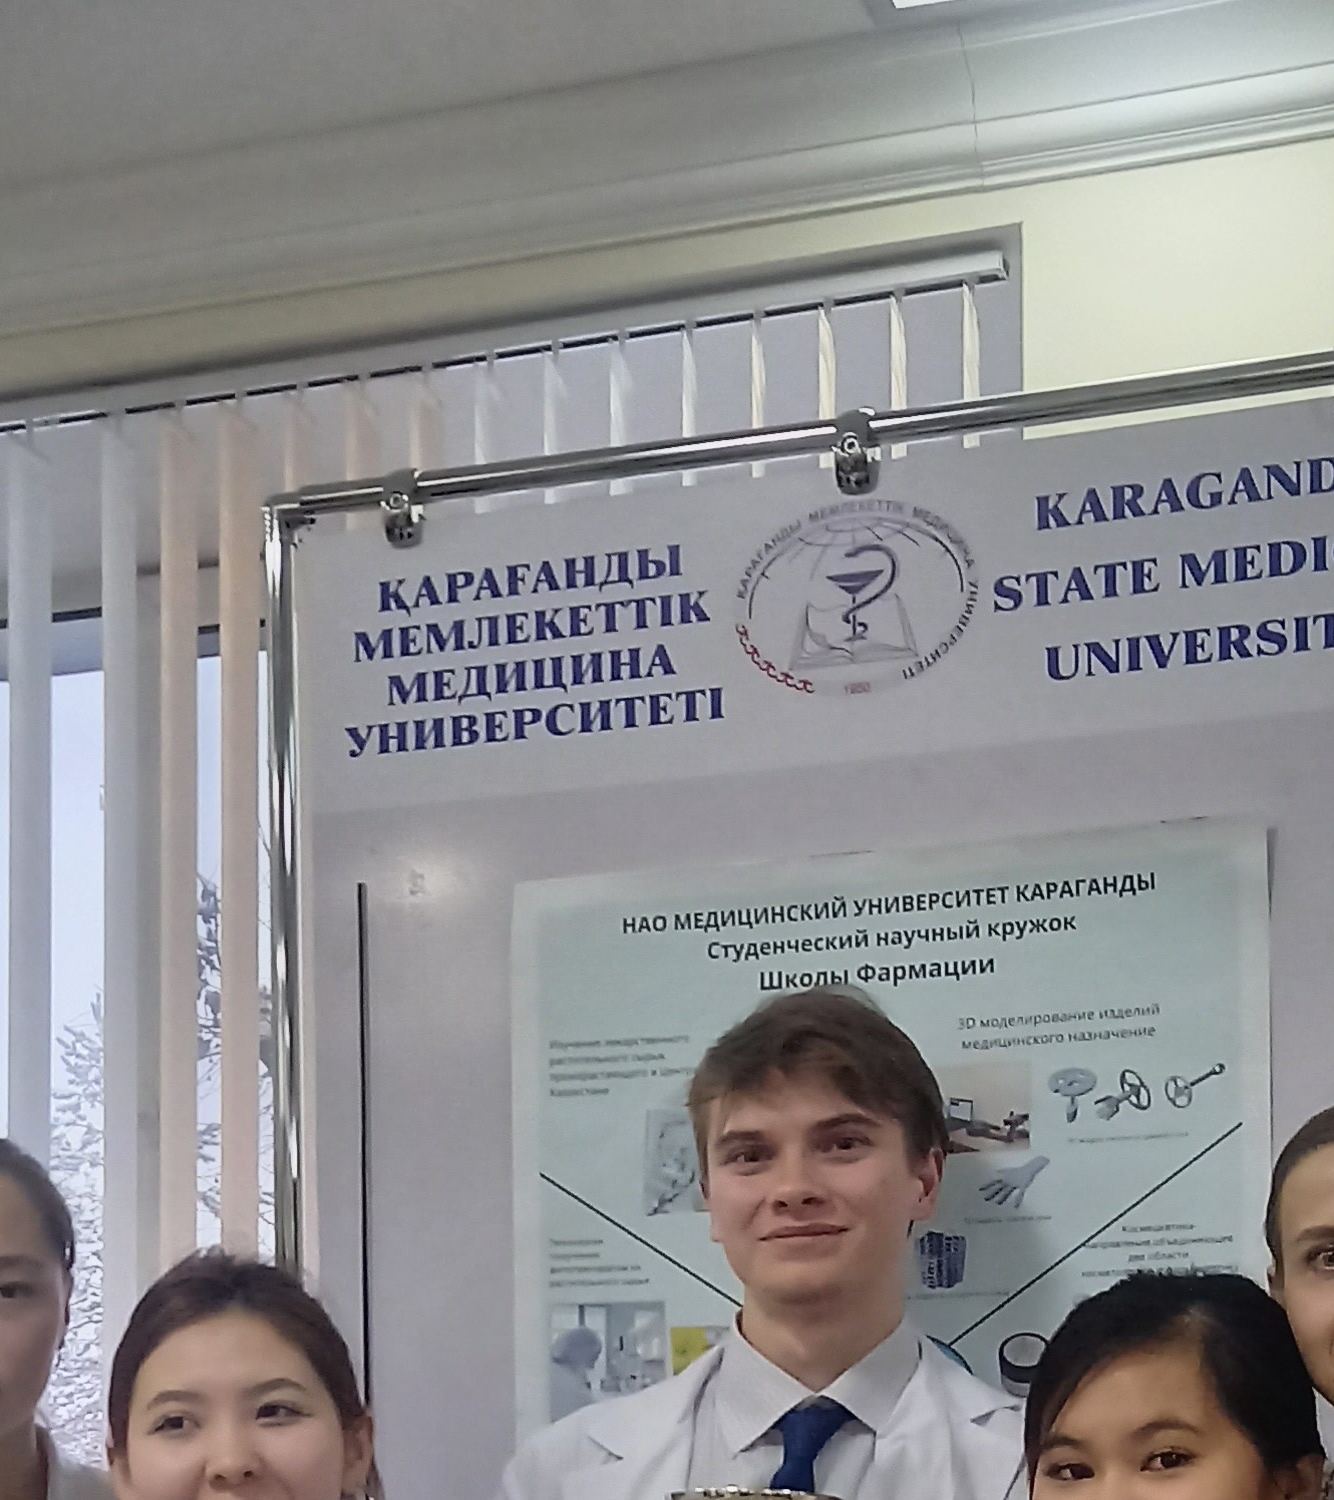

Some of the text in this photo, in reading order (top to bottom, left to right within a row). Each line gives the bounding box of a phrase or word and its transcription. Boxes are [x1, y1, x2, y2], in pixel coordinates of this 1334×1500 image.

[377, 544, 683, 617] ҚАРАҒАНДЫ
[993, 557, 1160, 613] STATE
[352, 589, 711, 663] МЕМЛЕКЕТТІК
[387, 643, 677, 706] МЕДИЦИНА
[344, 686, 726, 758] УНИВЕРСИТЕТІ
[622, 872, 1156, 934] НАО МЕДИЦИНСКИЙ УНИВЕРСИТЕТ КАРАГАНДЫ
[707, 915, 1077, 963] Студенческий научный кружок
[759, 957, 996, 991] Школы Фармации
[961, 1025, 1157, 1051] медицинского назначение
[979, 1008, 1095, 1030] моделирование
[1099, 1002, 1161, 1020] изделий
